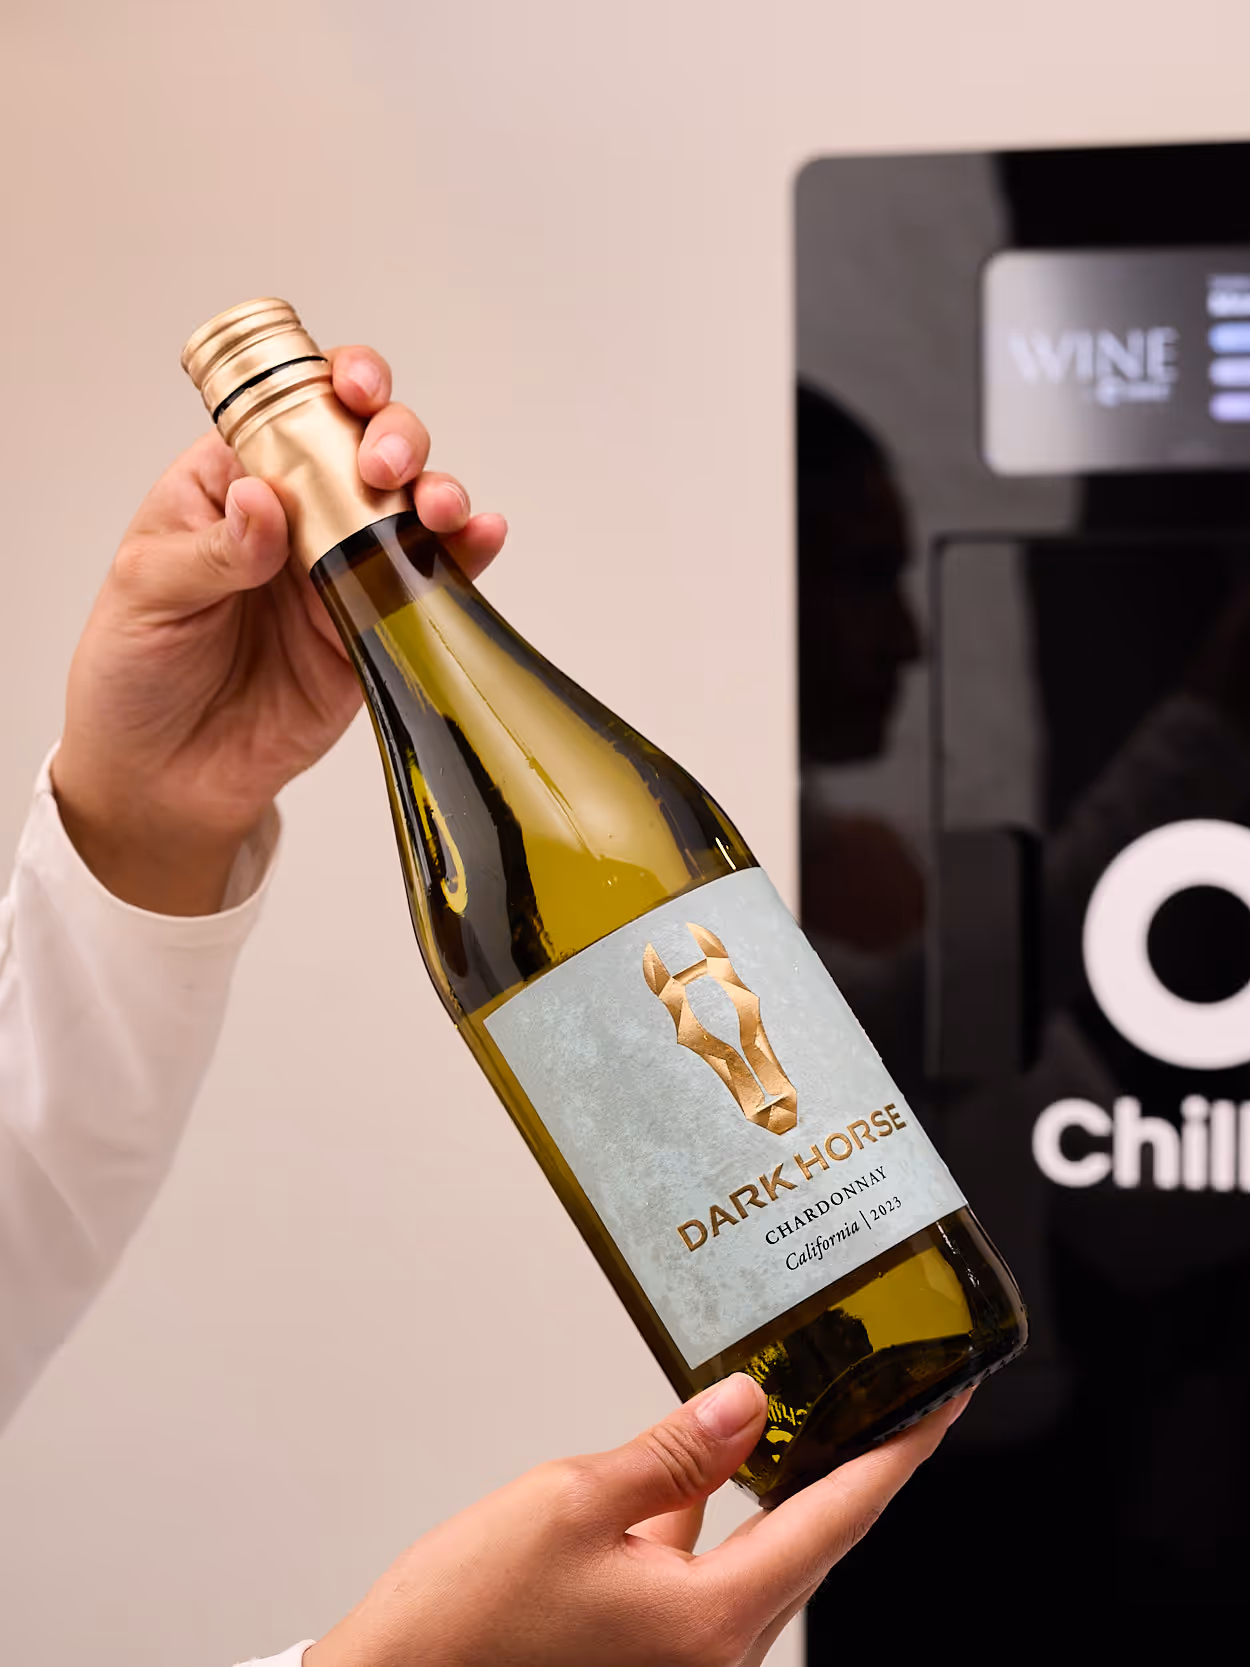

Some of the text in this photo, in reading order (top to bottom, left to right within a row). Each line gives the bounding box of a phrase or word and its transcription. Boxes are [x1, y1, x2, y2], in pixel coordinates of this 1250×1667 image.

[1006, 327, 1180, 384] WINE
[677, 1103, 907, 1252] DARK HORSE
[765, 1166, 887, 1246] CHARDONNAY
[785, 1219, 861, 1271] California
[869, 1195, 902, 1222] 2023
